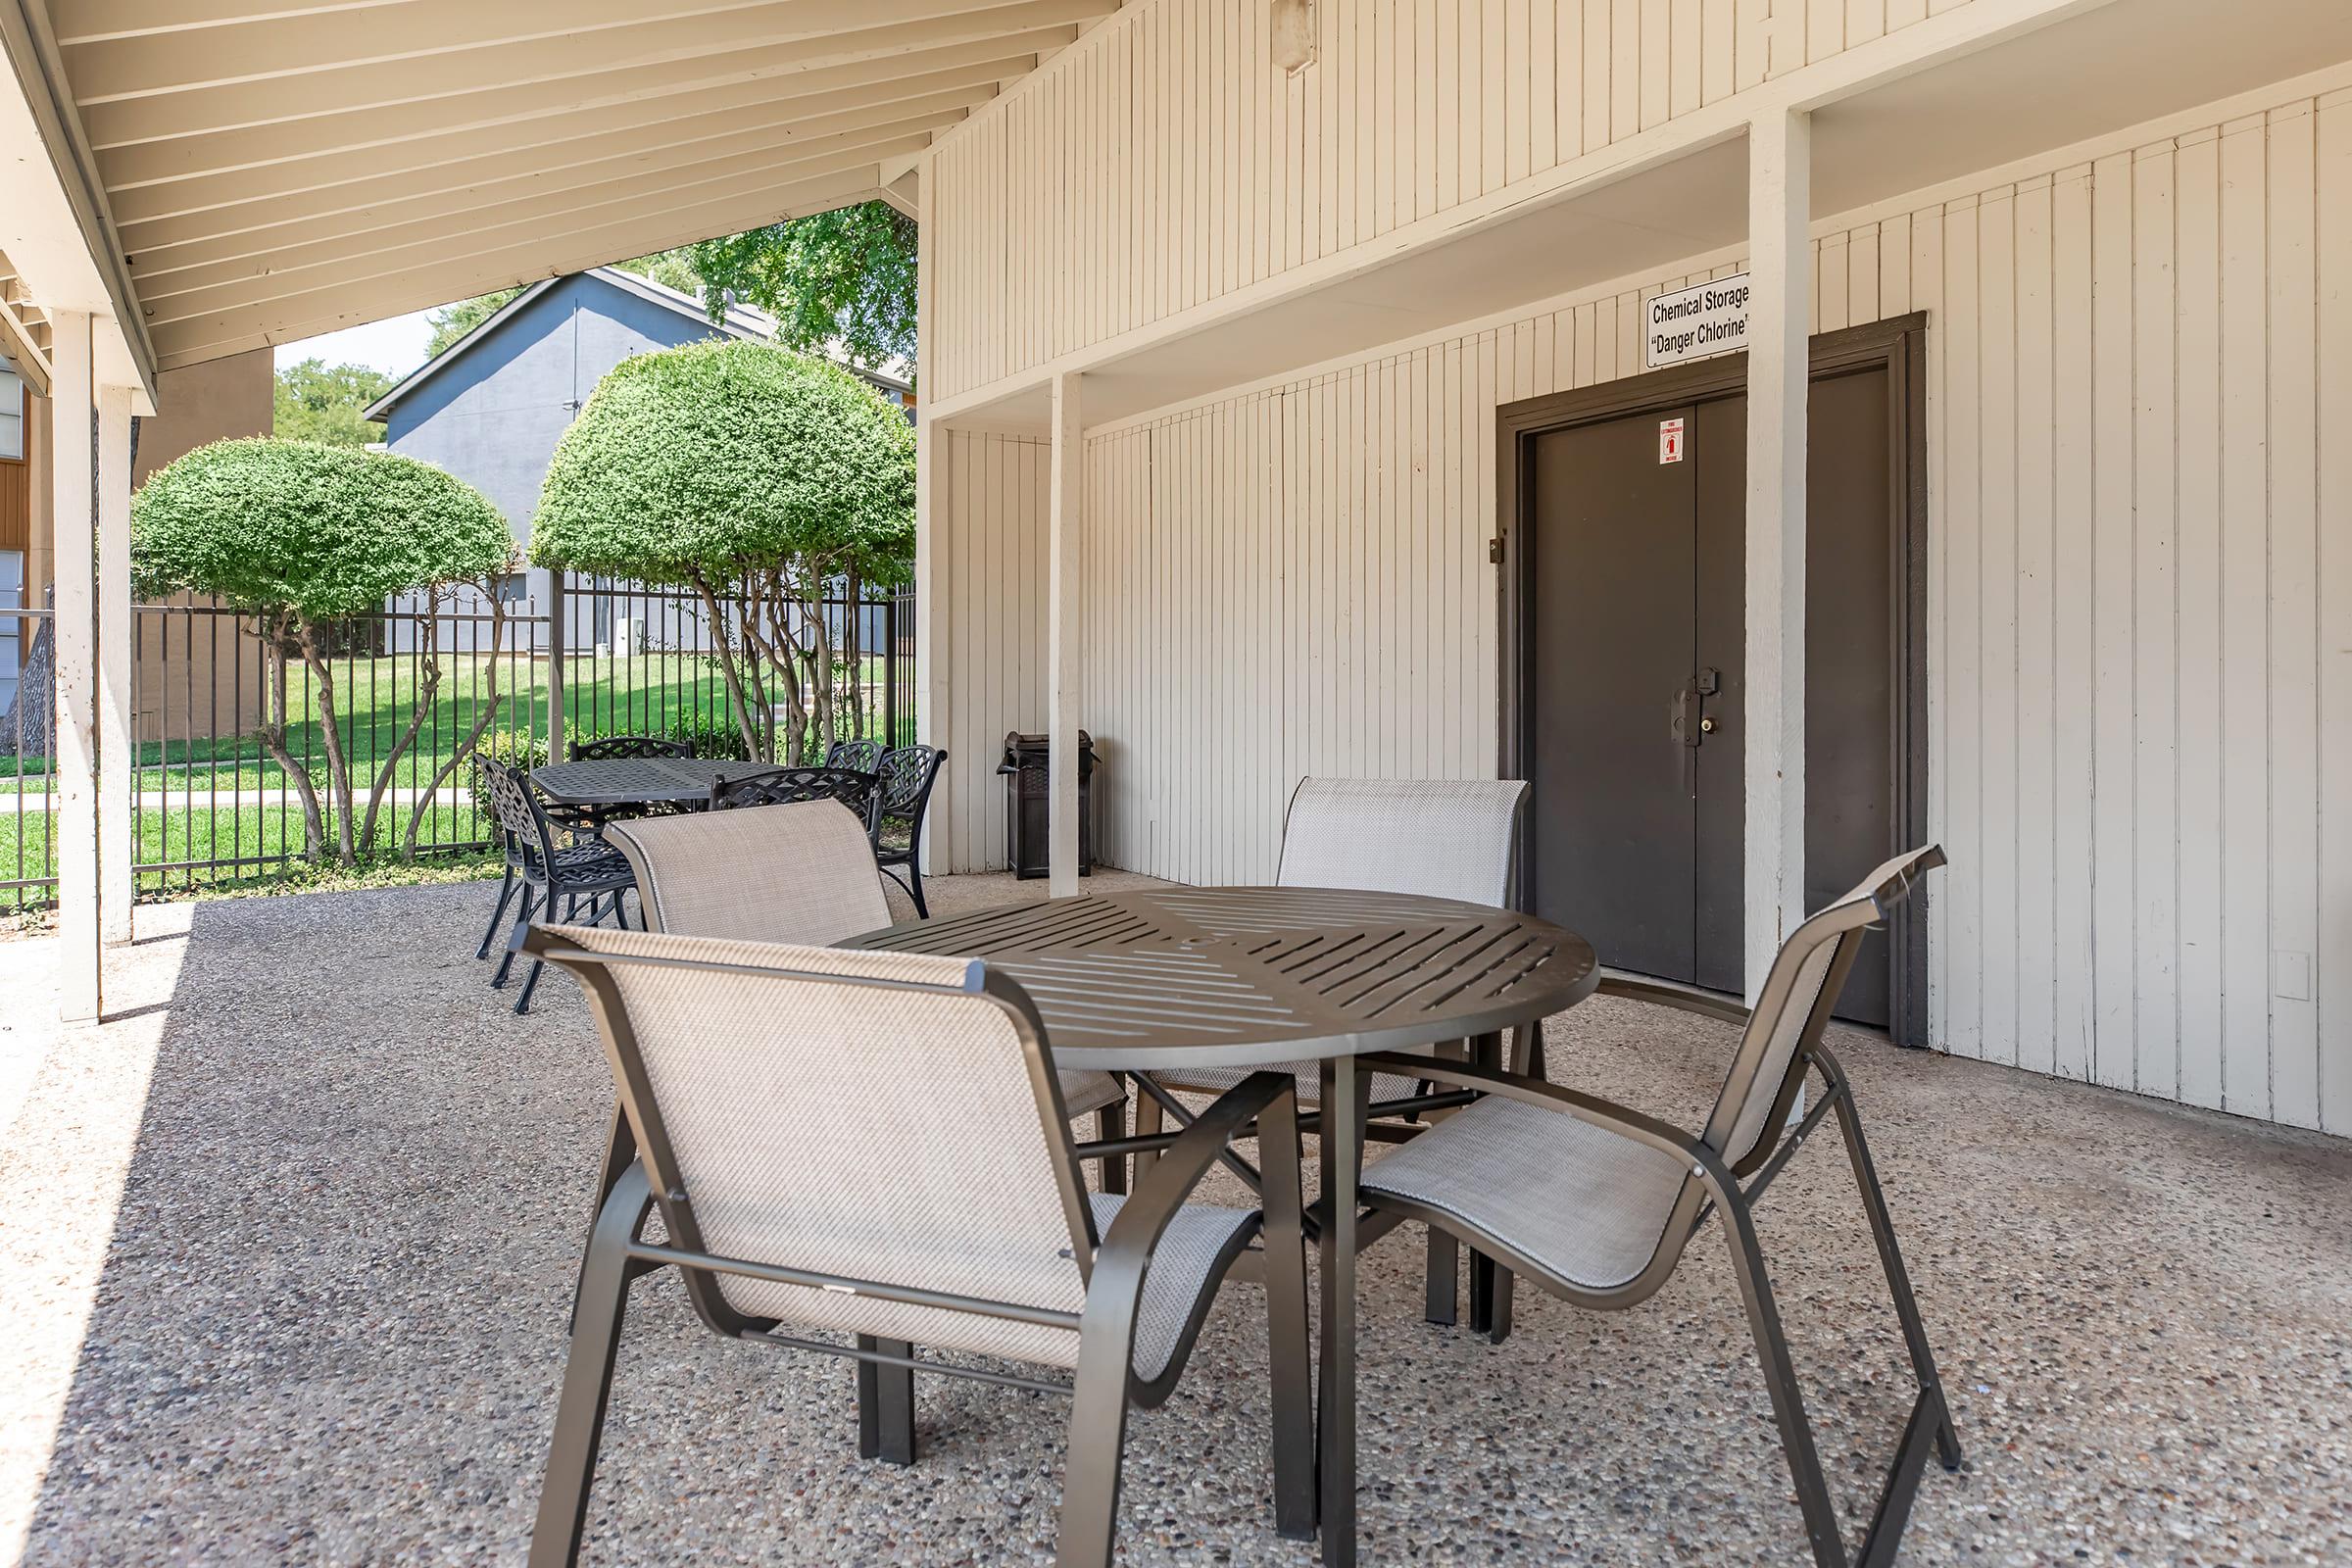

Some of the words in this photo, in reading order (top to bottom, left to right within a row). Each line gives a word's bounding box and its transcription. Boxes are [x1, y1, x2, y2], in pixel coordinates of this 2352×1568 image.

[1653, 294, 1701, 323] Chemical
[1705, 286, 1749, 311] Storage
[1651, 331, 1694, 354] “Danger
